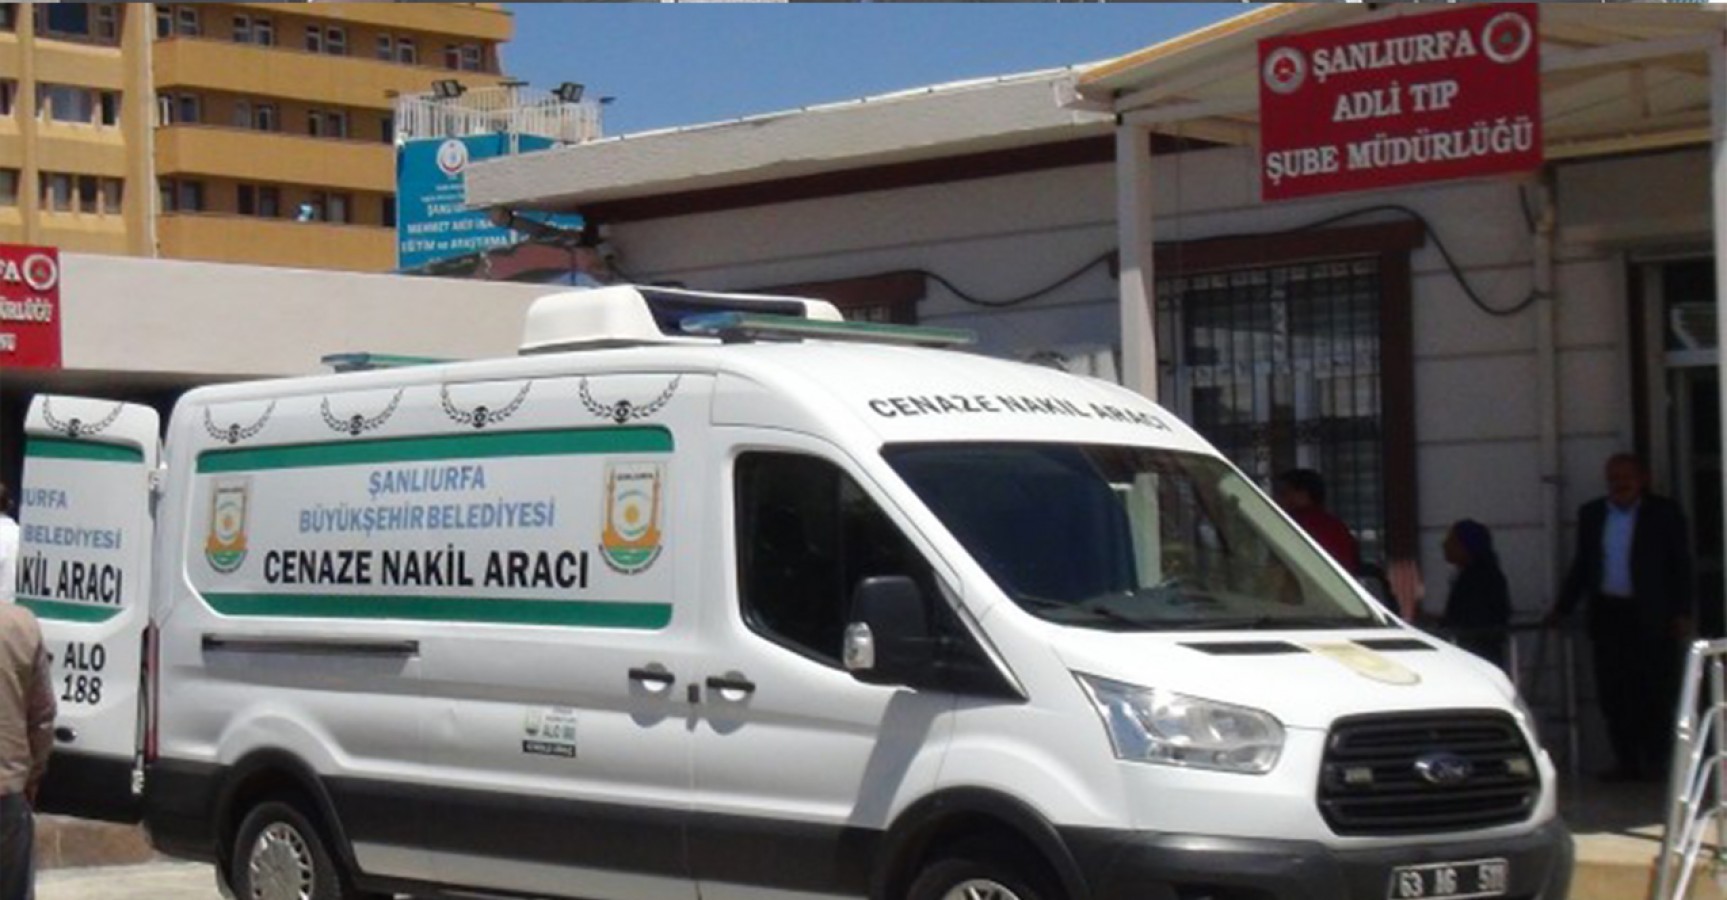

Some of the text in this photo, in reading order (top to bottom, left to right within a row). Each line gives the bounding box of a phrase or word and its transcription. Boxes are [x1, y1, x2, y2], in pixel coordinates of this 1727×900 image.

[1312, 29, 1477, 83] ŞANLIURFA
[1332, 79, 1459, 122] ADLİ TIP
[1266, 116, 1533, 186] ŞUBE MÜDÜRLÜĞÜ
[868, 394, 1001, 418] CENAZE
[1089, 402, 1173, 432] ARACI
[367, 464, 486, 500] ŞANLIURFA
[24, 523, 122, 550] BELEDİYESİ
[299, 497, 556, 538] BÜYÜKŞEHİR BELEDİYESİ
[56, 560, 123, 605] ARACI
[264, 550, 372, 584] CENAZE
[381, 543, 474, 588] NAKİL
[483, 550, 589, 589] ARACI
[62, 642, 105, 672] ALO
[61, 674, 101, 705] 188
[1400, 871, 1424, 898] 63
